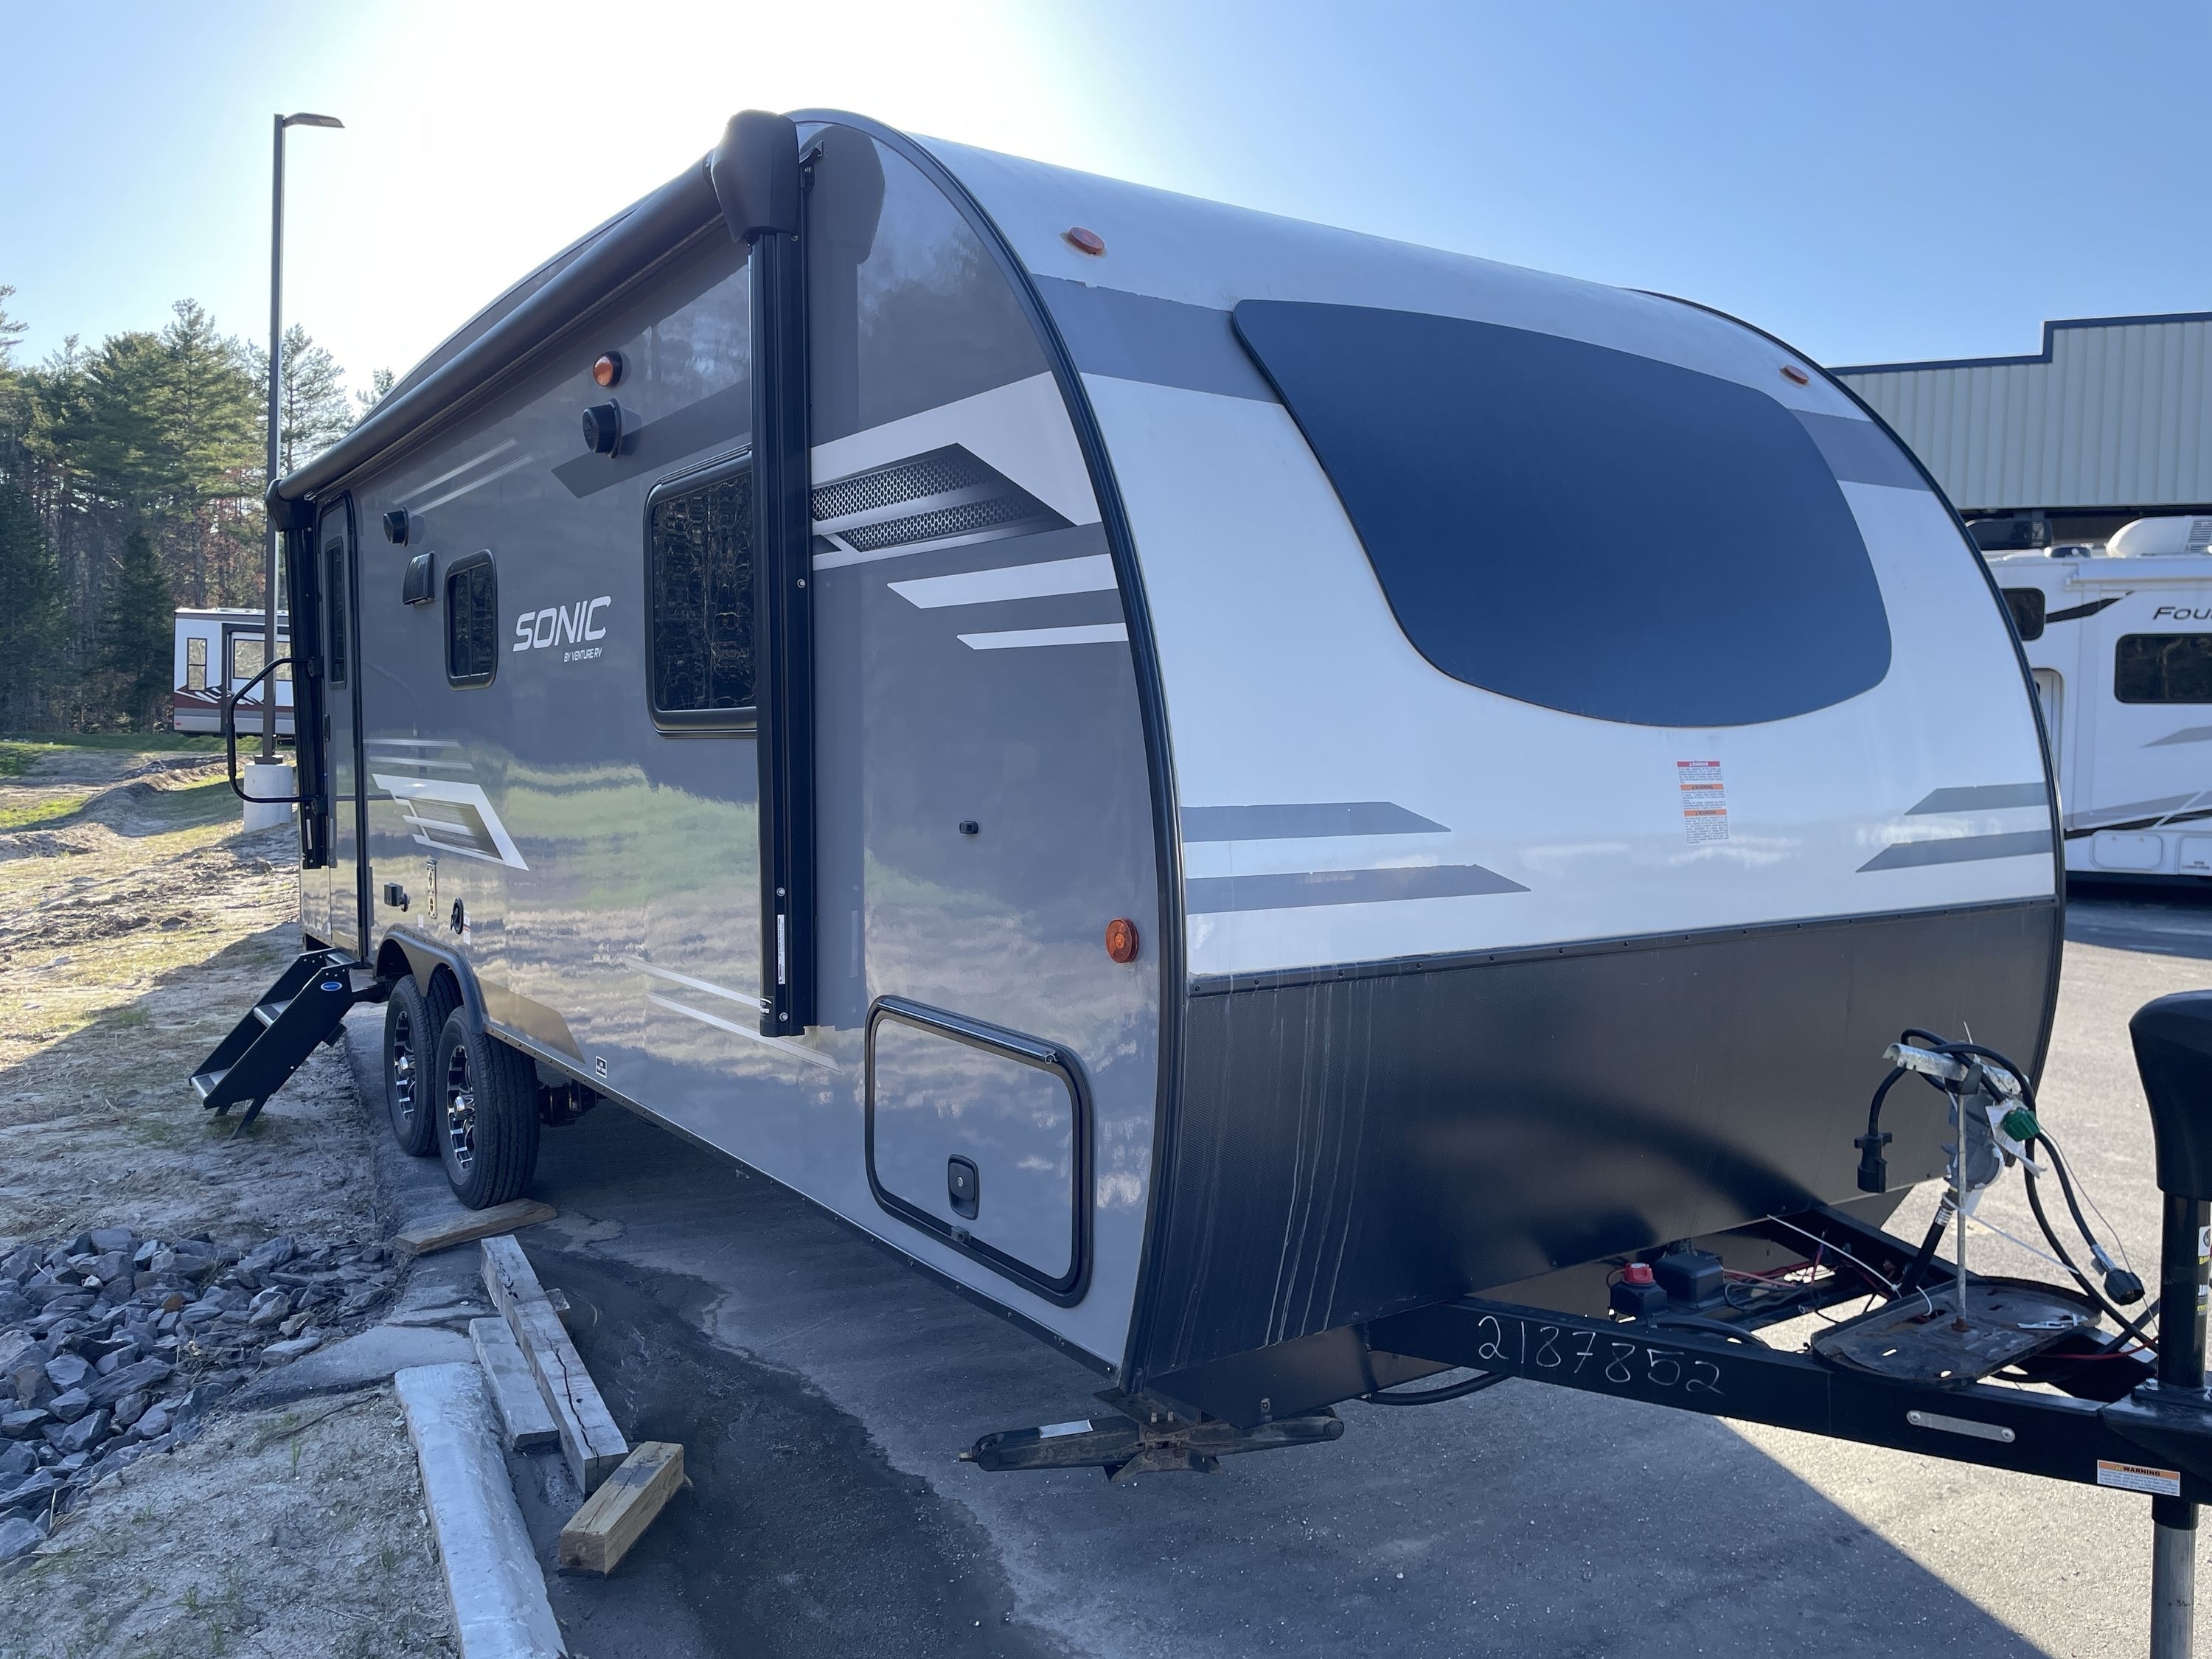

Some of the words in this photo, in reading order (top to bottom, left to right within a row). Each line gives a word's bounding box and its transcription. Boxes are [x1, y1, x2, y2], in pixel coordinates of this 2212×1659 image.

[2152, 607, 2212, 620] Fou
[513, 595, 611, 652] SONIC
[563, 652, 571, 662] BY
[571, 648, 594, 661] VENTURE
[594, 647, 602, 658] RV
[1478, 1315, 1726, 1396] 2187852
[2124, 1466, 2160, 1476] WARNING
